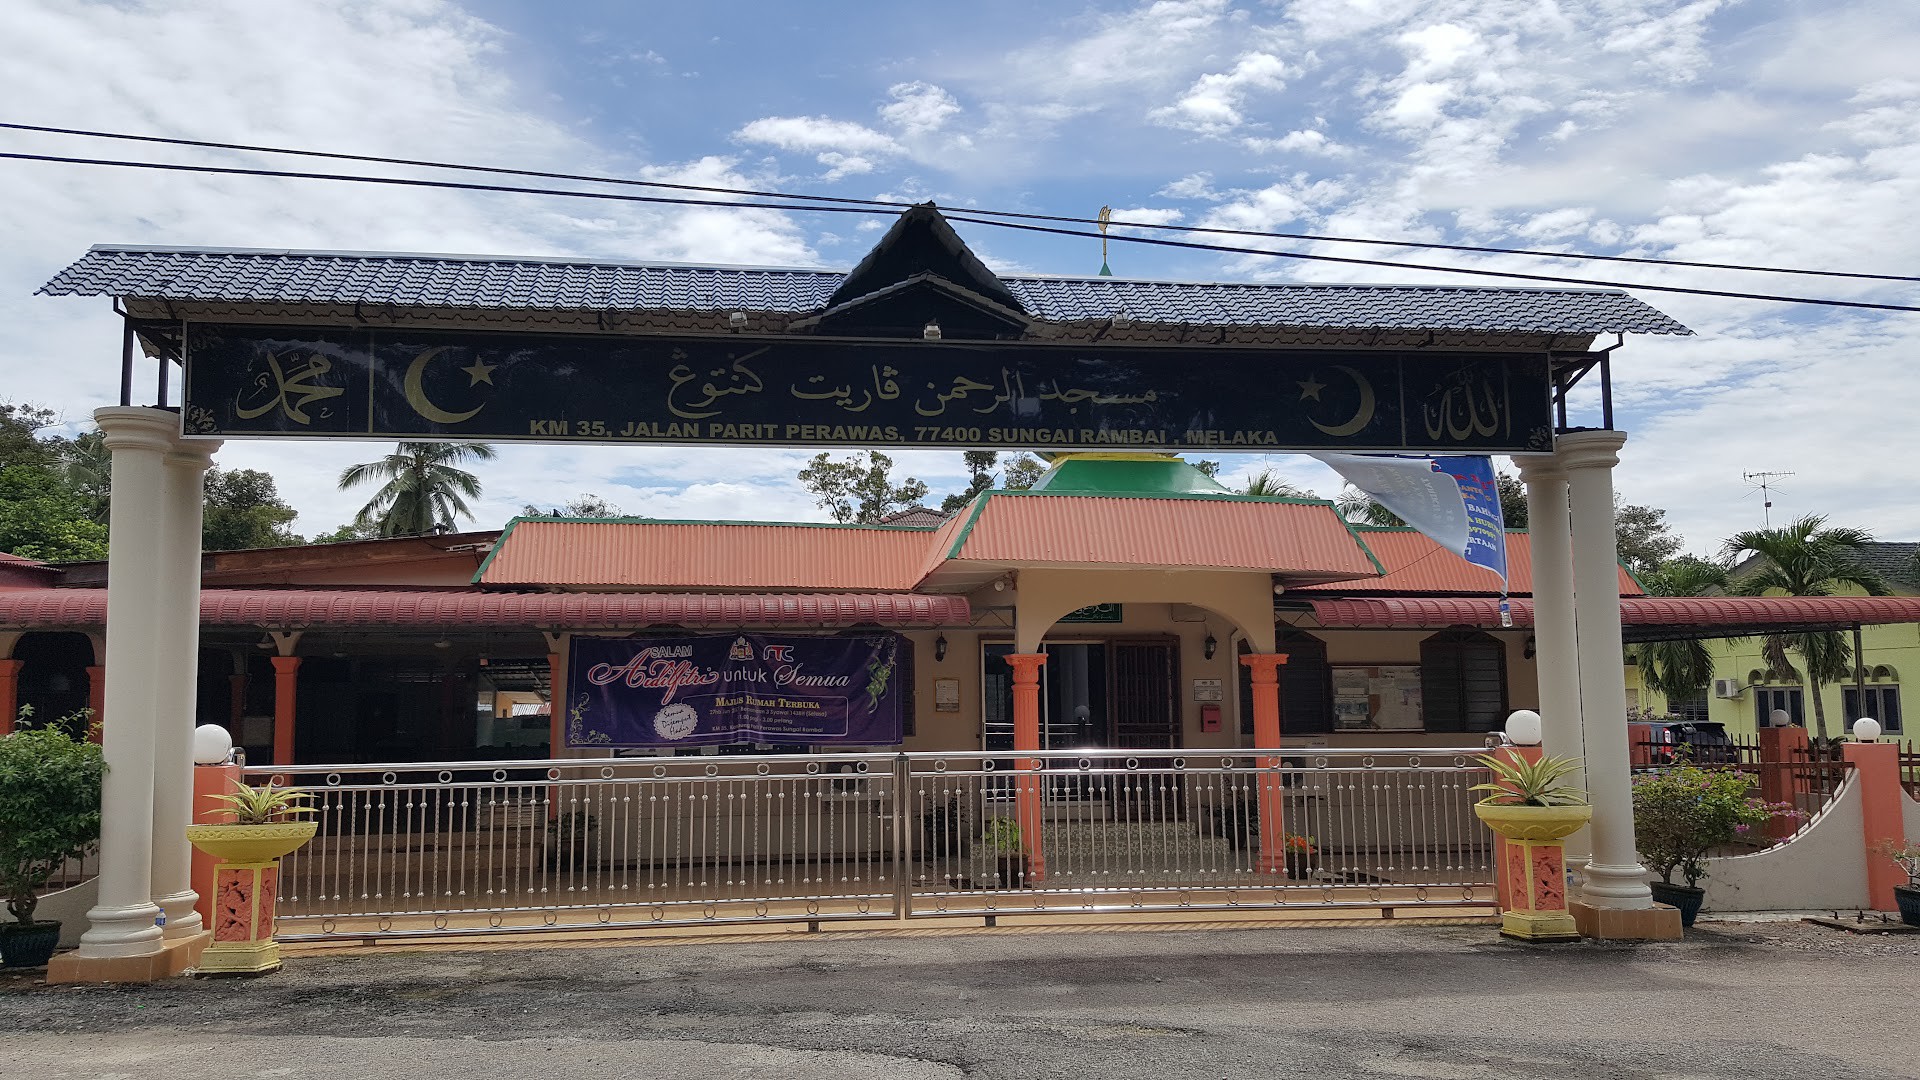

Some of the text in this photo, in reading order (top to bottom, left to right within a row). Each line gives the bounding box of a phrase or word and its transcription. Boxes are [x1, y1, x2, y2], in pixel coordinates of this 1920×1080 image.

[914, 365, 1025, 418] الرحمن
[530, 419, 569, 436] KM
[576, 420, 612, 438] 35,
[620, 421, 700, 438] JALAN
[709, 423, 779, 439] PARIT
[786, 424, 905, 442] PERAWAS,
[914, 426, 982, 442] 77400
[988, 427, 1074, 444] SUNGAI
[1080, 428, 1166, 444] RAMBAI
[1187, 429, 1279, 445] MELAKA
[650, 644, 693, 659] SALAM
[588, 647, 850, 705] Aidilfitri untuk Semua
[745, 695, 776, 707] RUMAH
[777, 697, 821, 709] TERBUKA
